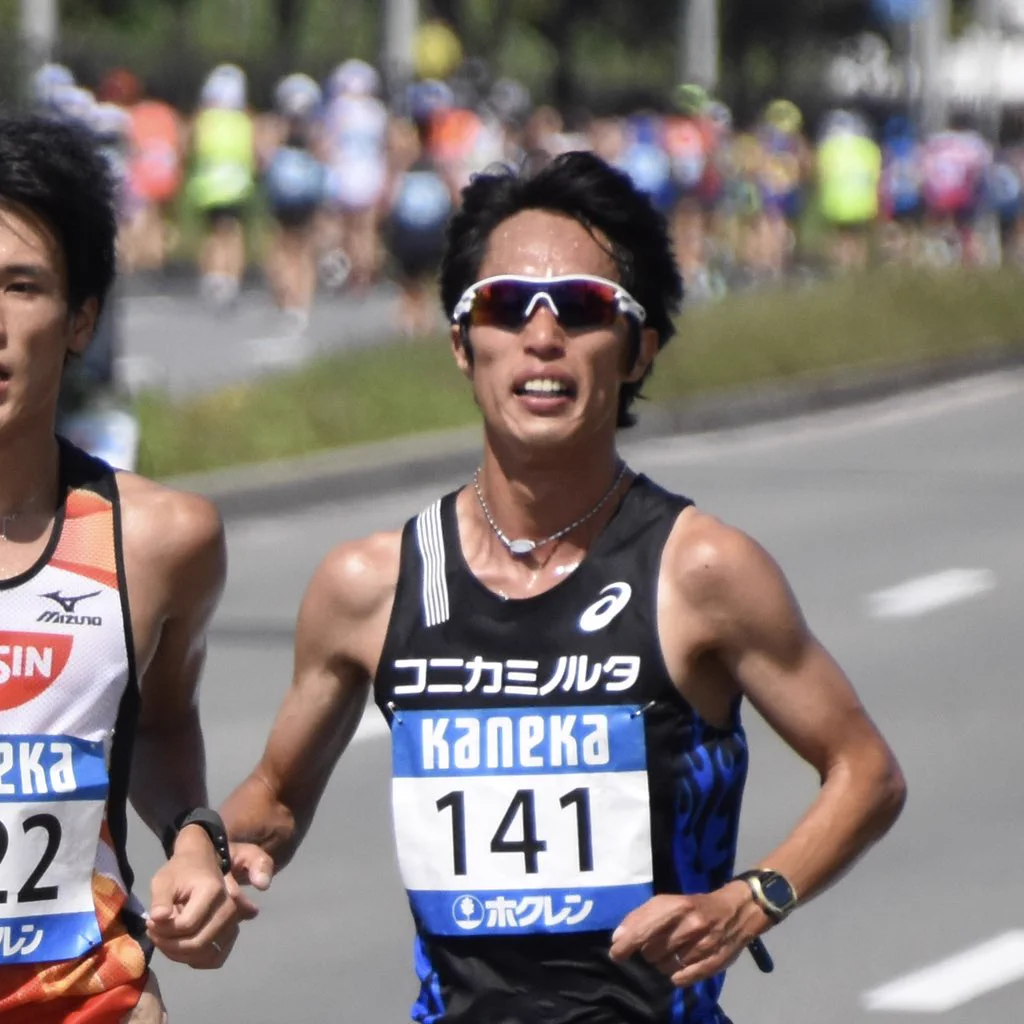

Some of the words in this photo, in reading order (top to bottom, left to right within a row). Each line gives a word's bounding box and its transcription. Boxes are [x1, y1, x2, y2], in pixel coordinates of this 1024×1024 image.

[36, 610, 102, 626] MIZUNO
[394, 655, 641, 696] コニカミノルタ
[436, 788, 594, 875] 141
[485, 895, 593, 928] ホクレン
